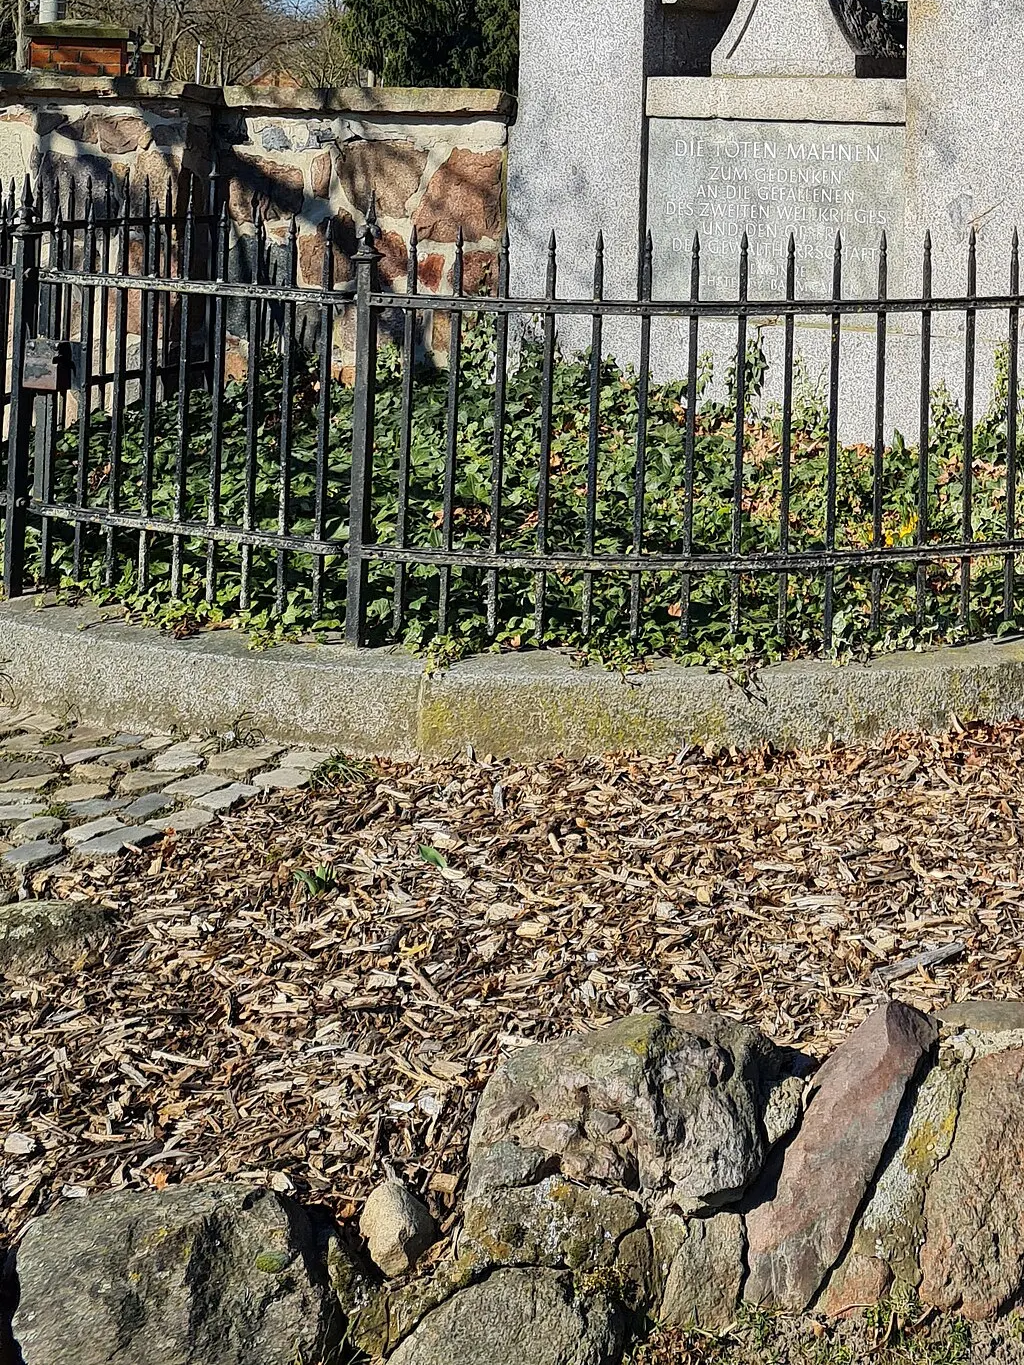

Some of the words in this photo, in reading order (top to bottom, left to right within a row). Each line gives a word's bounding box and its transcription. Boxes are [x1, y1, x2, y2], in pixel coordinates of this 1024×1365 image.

[675, 139, 705, 157] DIE
[713, 140, 777, 159] TOTEN
[786, 143, 880, 163] MAHNEN
[709, 166, 748, 181] ZUM
[754, 167, 842, 184] GEDENKEN
[696, 184, 718, 199] AN
[726, 185, 750, 200] DIE
[757, 186, 855, 204] GEFALLENEN
[665, 201, 694, 216] DES
[700, 203, 770, 219] ZWEITEN
[777, 205, 887, 225] WELTKRIEGES
[702, 221, 738, 237] UND
[745, 223, 777, 239] DEN
[784, 224, 846, 242] OPFERN
[672, 237, 698, 253] DE
